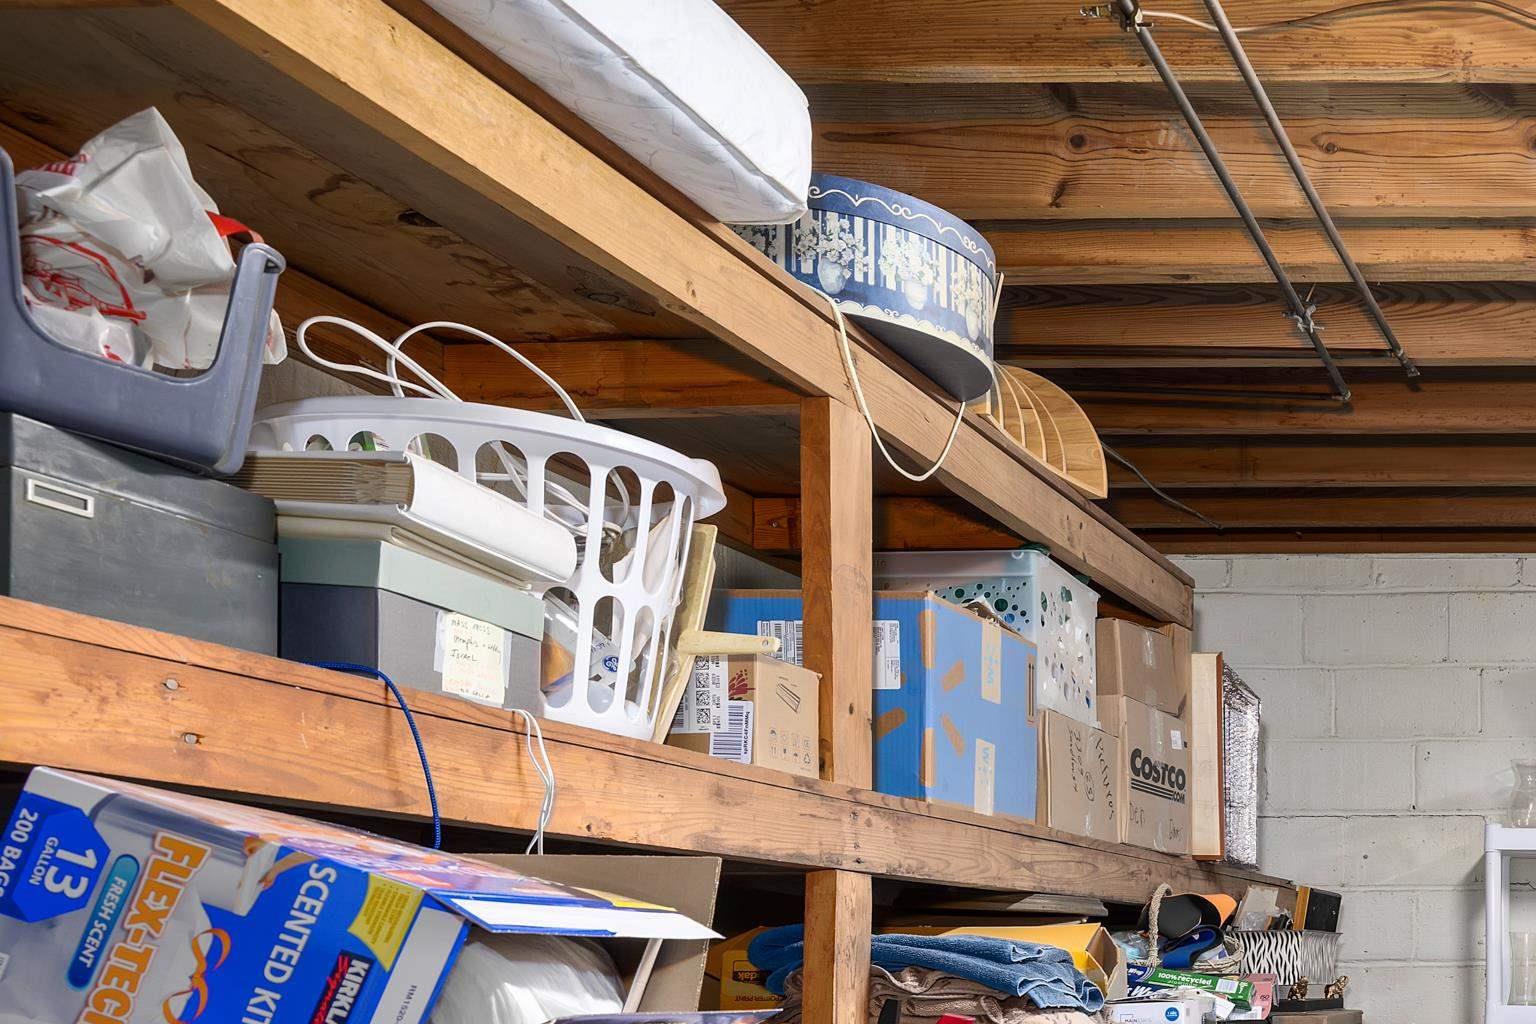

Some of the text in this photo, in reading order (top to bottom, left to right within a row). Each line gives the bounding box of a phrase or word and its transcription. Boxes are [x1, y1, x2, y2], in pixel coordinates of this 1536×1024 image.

[1130, 748, 1186, 791] COSTCO
[0, 807, 38, 898] 200 BAG
[28, 836, 60, 887] GALLON
[44, 848, 99, 899] 13
[78, 875, 129, 968] FRESH SCENT
[263, 863, 337, 984] SCENTED
[1158, 973, 1212, 986] 100% recycled
